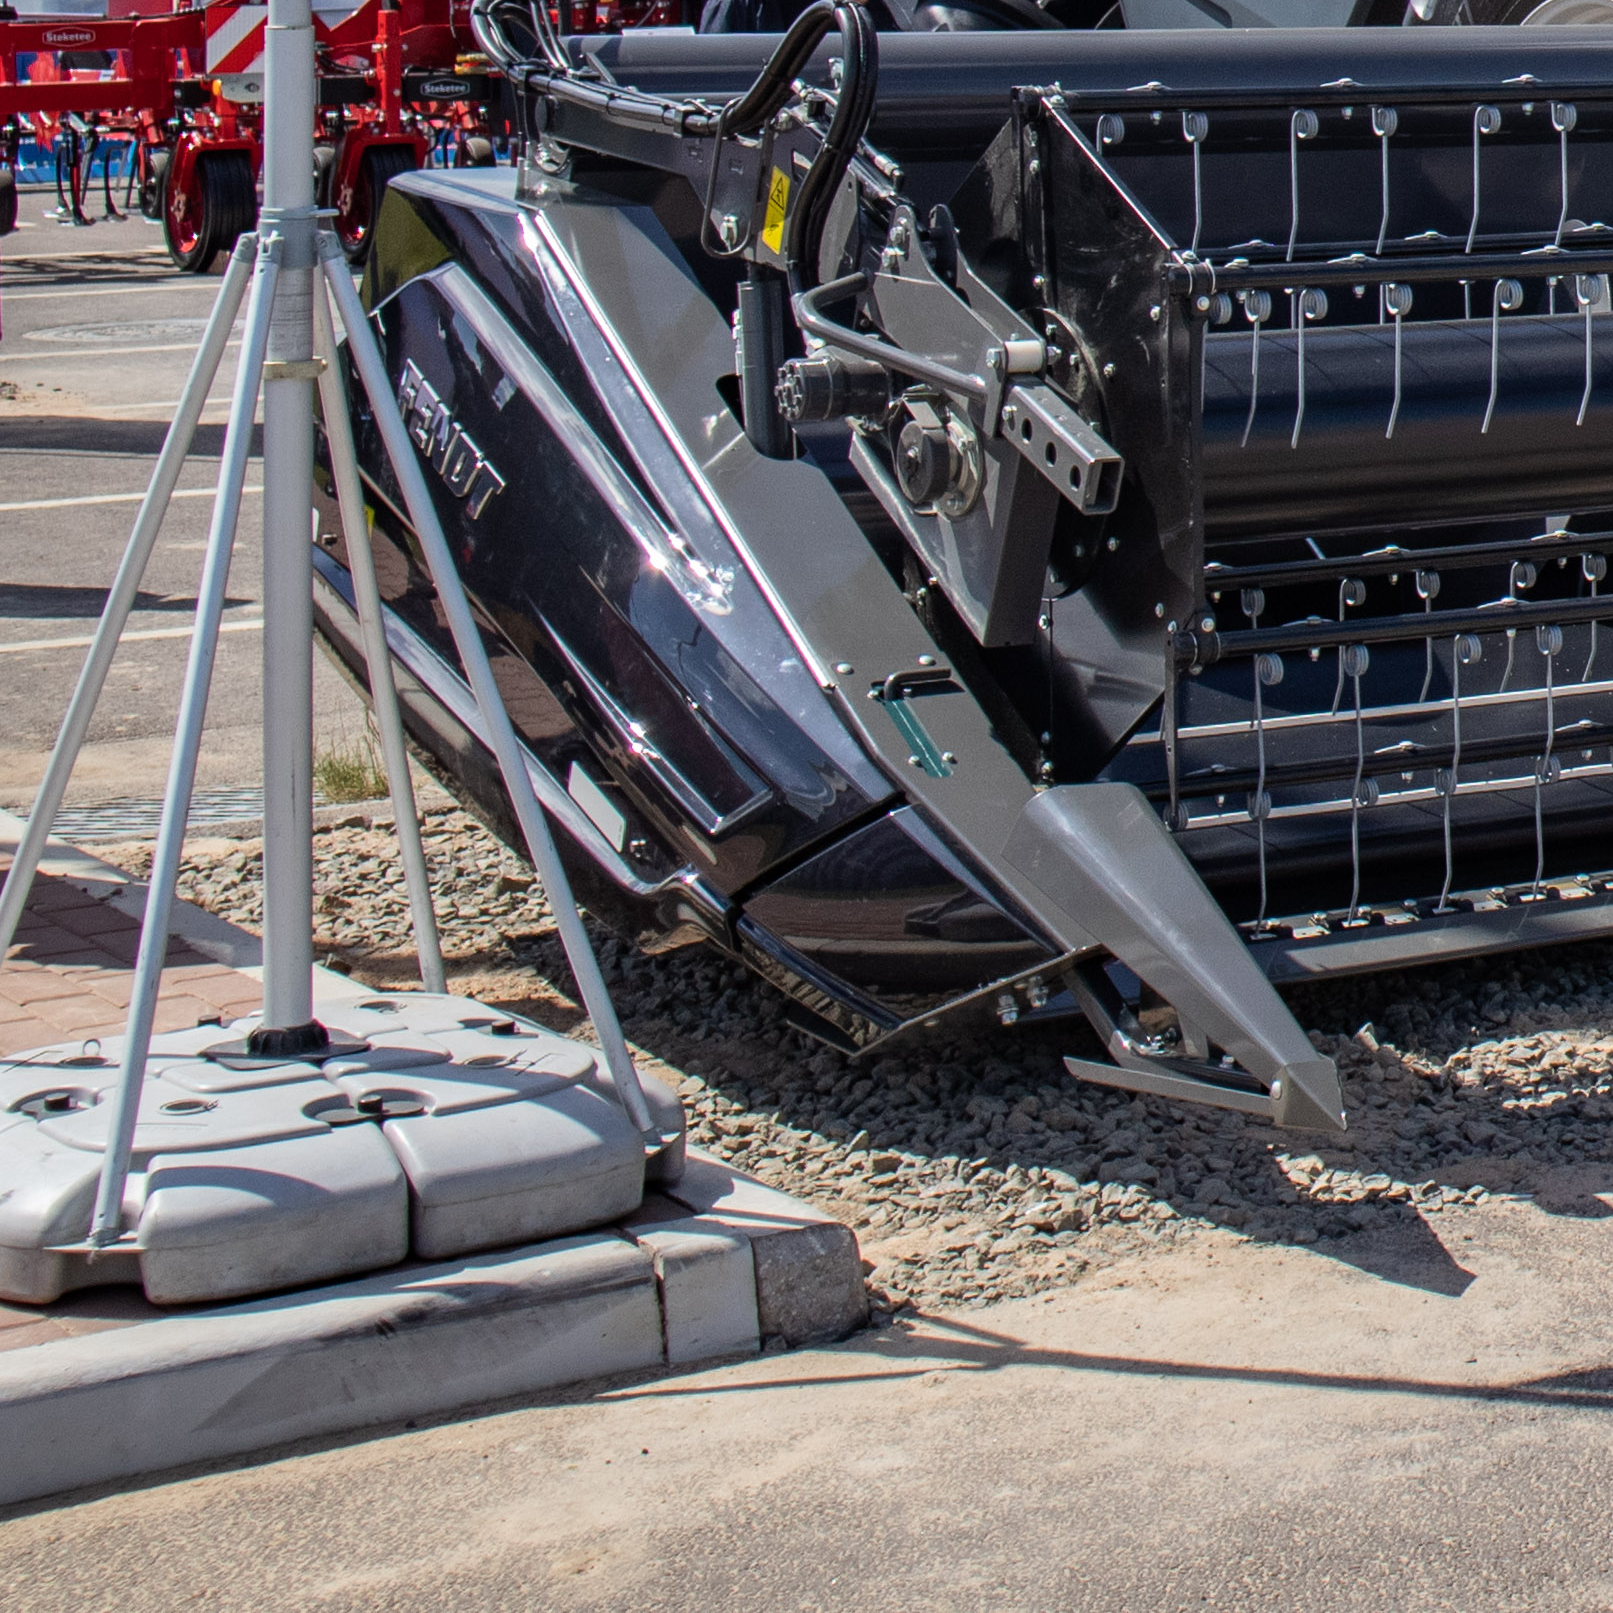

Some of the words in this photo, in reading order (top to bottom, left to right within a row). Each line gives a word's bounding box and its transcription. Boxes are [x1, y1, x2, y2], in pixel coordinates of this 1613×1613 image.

[46, 31, 91, 43] Steketee
[424, 84, 466, 93] Steketee
[398, 357, 507, 521] FENDT
